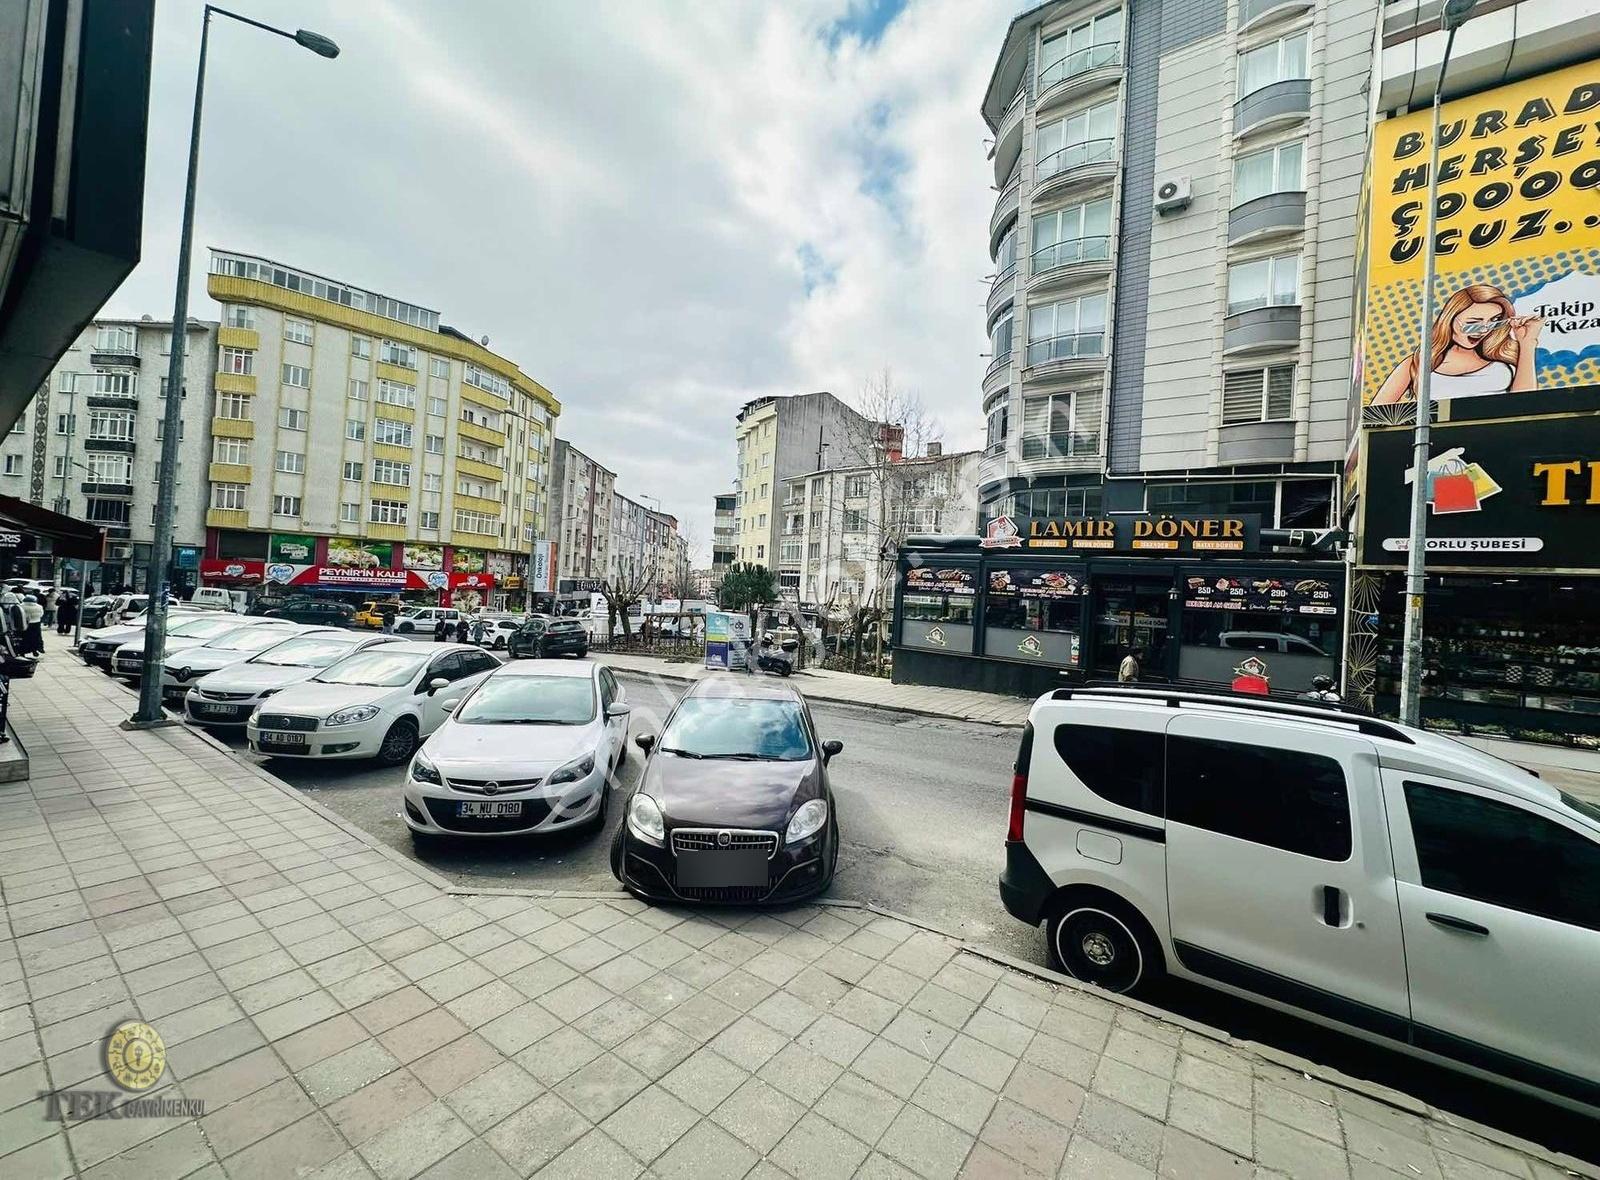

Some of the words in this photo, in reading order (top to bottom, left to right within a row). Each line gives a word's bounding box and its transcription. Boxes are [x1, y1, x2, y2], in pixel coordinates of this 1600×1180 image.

[1392, 121, 1600, 195] HERŞE
[1534, 301, 1594, 317] Takip
[1030, 516, 1115, 537] LAMİR
[1134, 514, 1244, 537] DÖNER
[1426, 540, 1467, 549] ORLU
[1470, 538, 1526, 550] ŞUBESİ
[376, 569, 407, 578] KALBİ
[463, 803, 474, 814] 34
[497, 803, 520, 814] 0180
